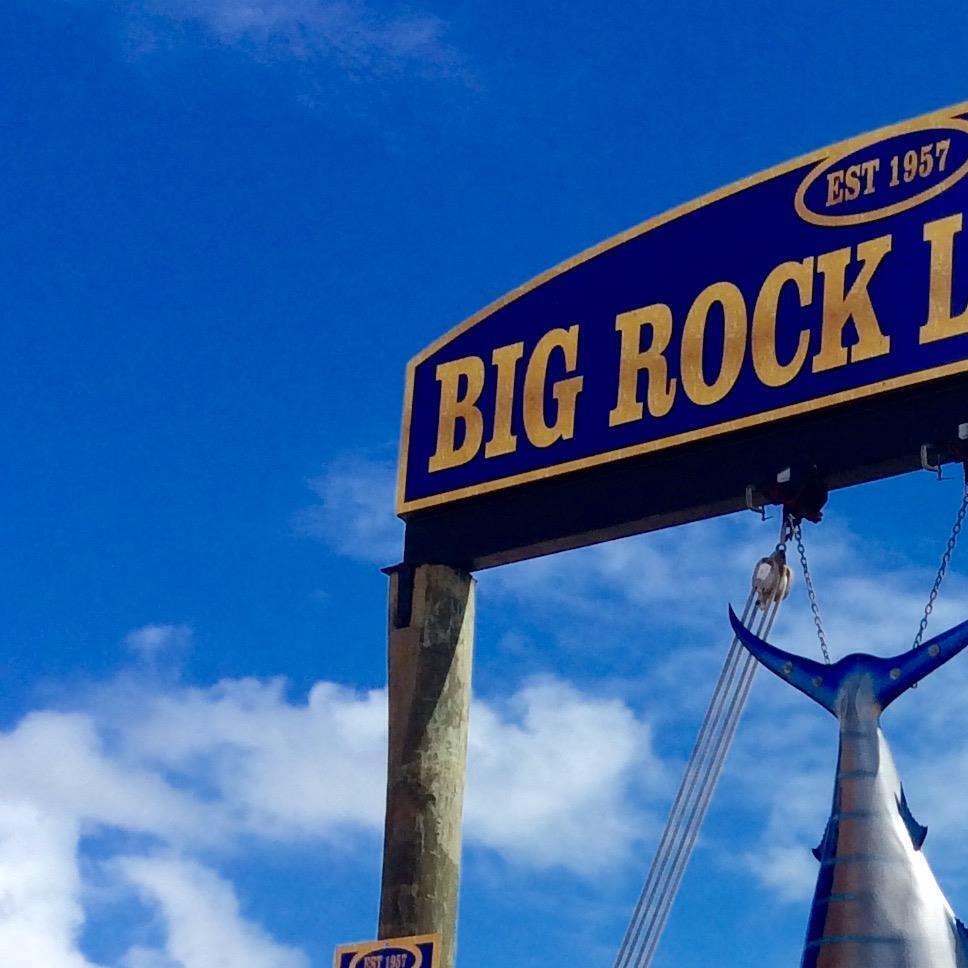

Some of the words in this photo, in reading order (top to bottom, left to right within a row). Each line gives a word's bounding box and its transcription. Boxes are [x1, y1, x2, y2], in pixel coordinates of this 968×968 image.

[825, 160, 880, 207] EST
[889, 138, 952, 187] 1957
[428, 324, 584, 474] BIG
[608, 233, 892, 427] ROCK
